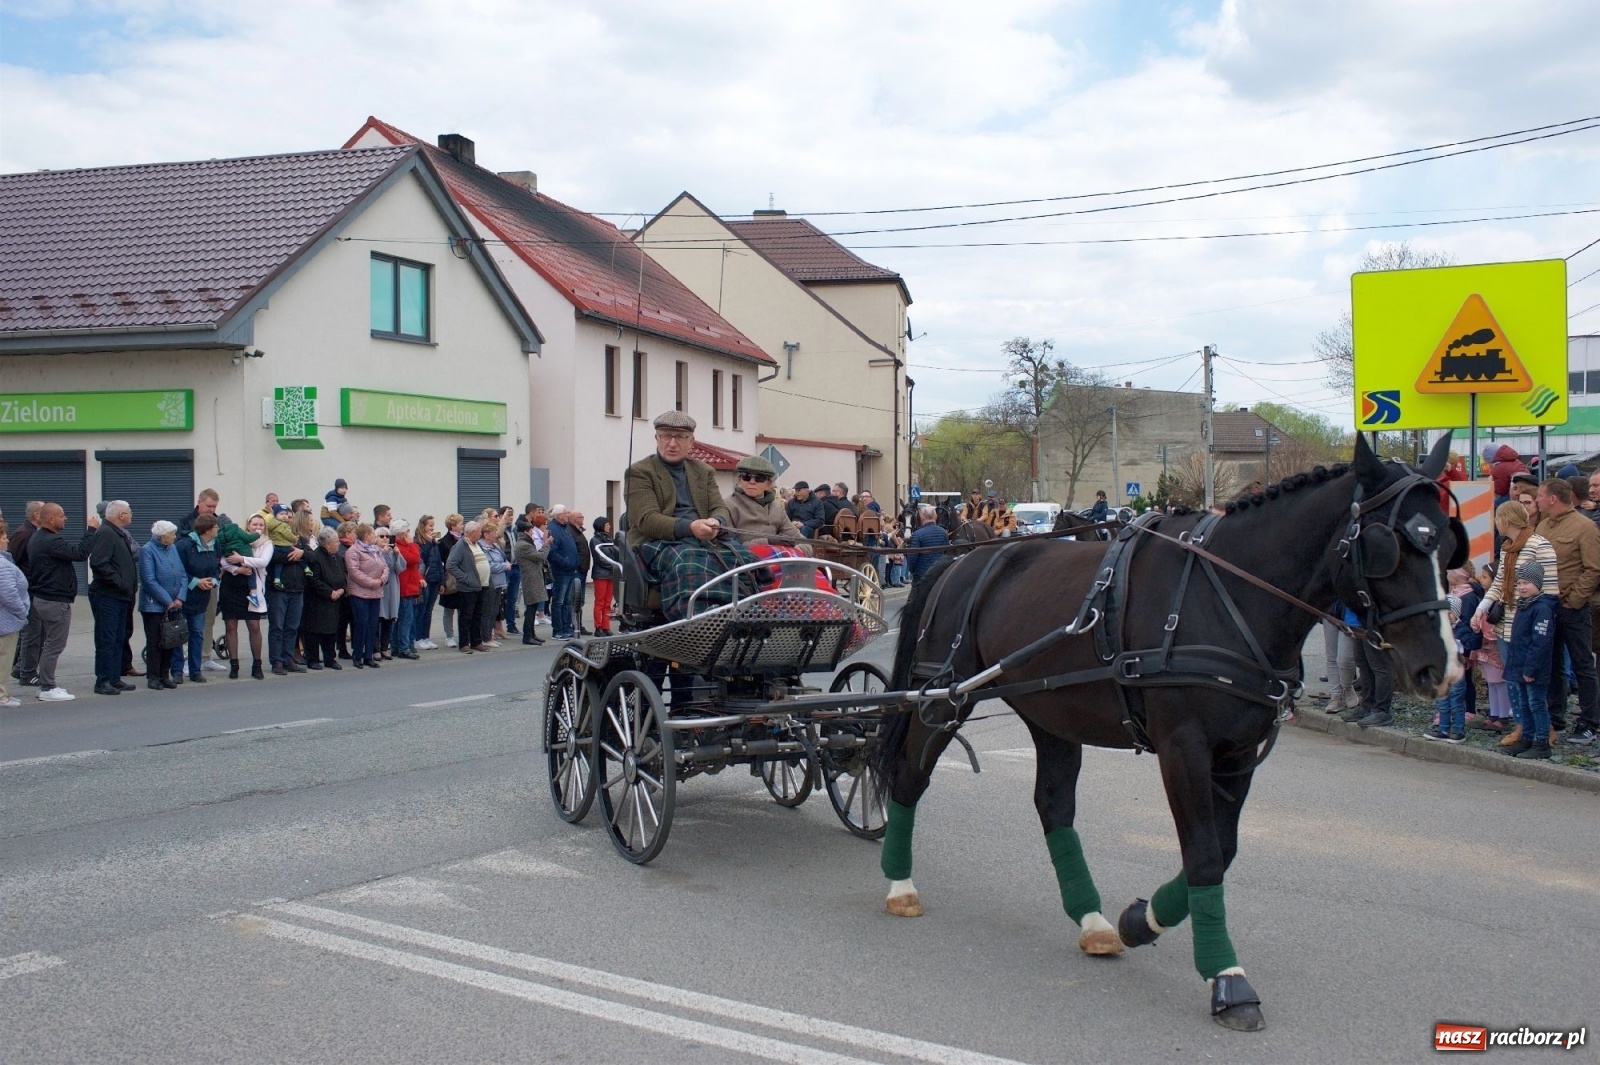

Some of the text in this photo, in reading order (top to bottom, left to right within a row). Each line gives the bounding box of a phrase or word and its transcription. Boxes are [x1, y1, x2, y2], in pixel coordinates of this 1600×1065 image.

[1, 401, 76, 423] Zielona
[387, 400, 479, 426] Apteka Zielona
